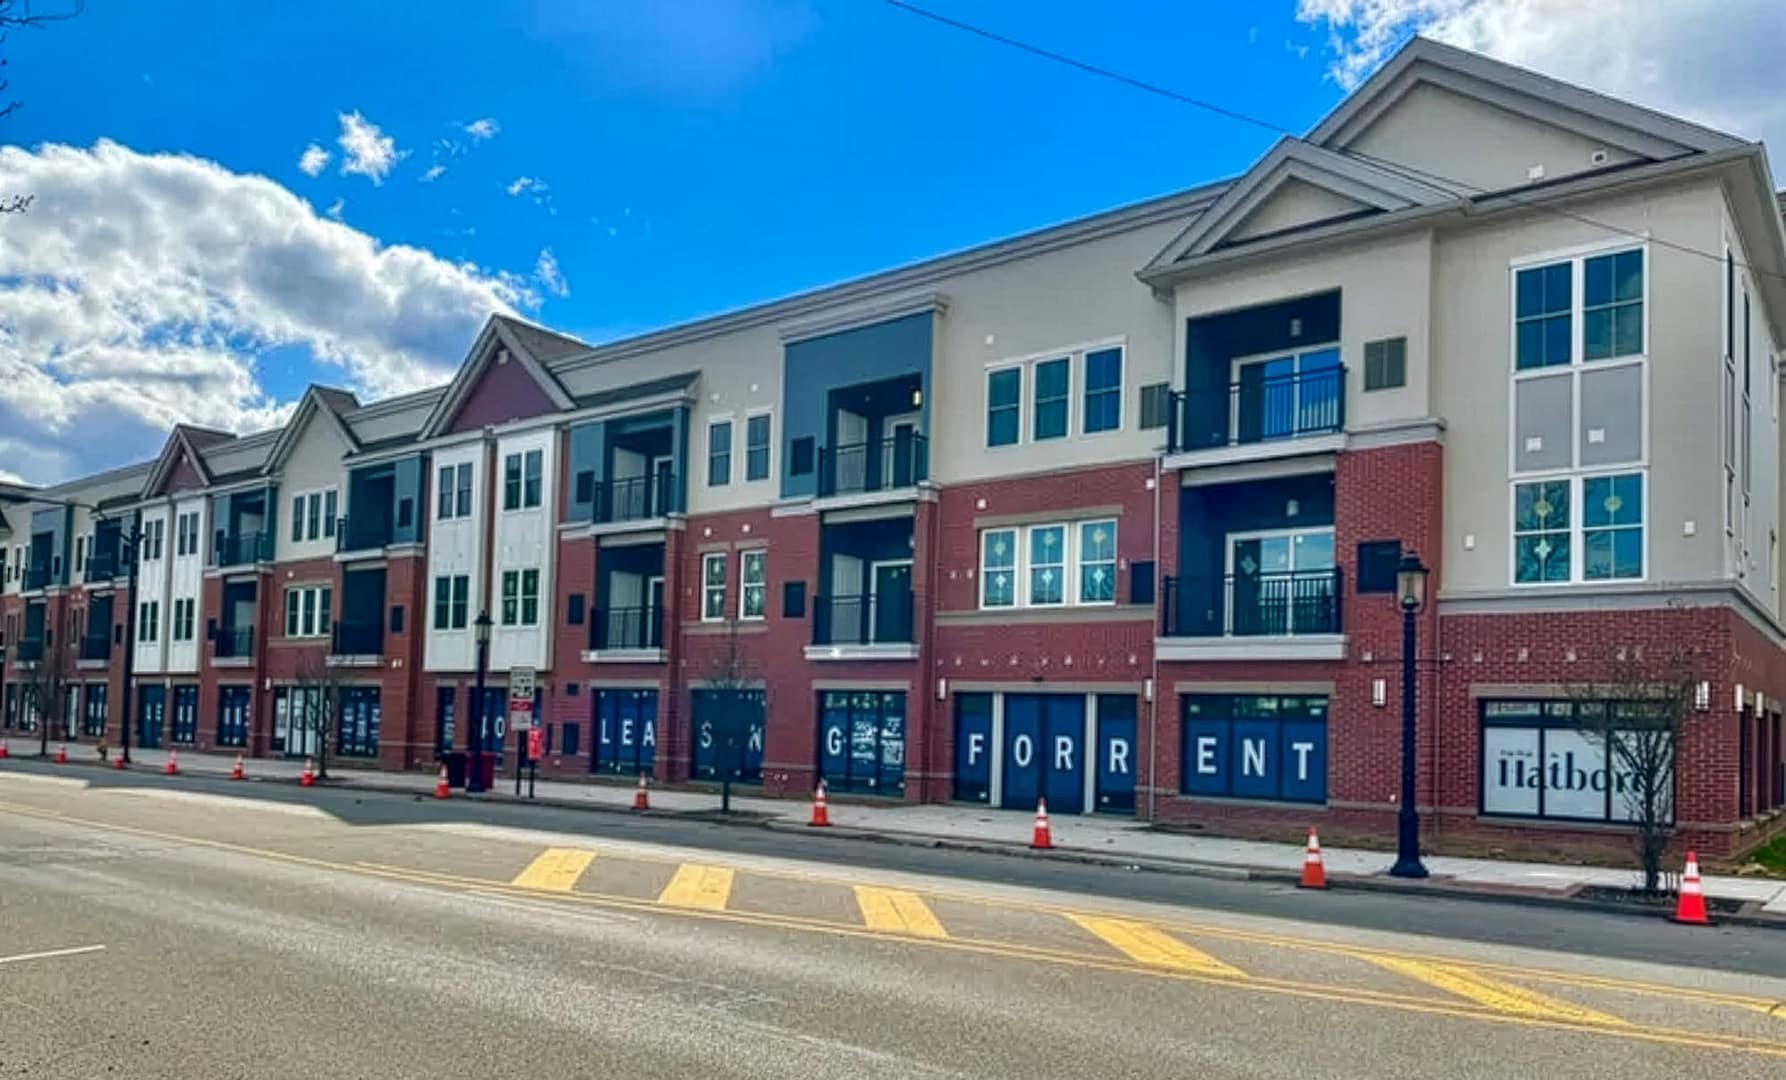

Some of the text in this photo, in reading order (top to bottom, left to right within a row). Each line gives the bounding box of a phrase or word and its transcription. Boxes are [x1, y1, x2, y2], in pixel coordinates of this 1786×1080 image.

[600, 718, 842, 757] LEASNG
[968, 733, 1073, 770] FOR
[1109, 737, 1314, 780] RENT
